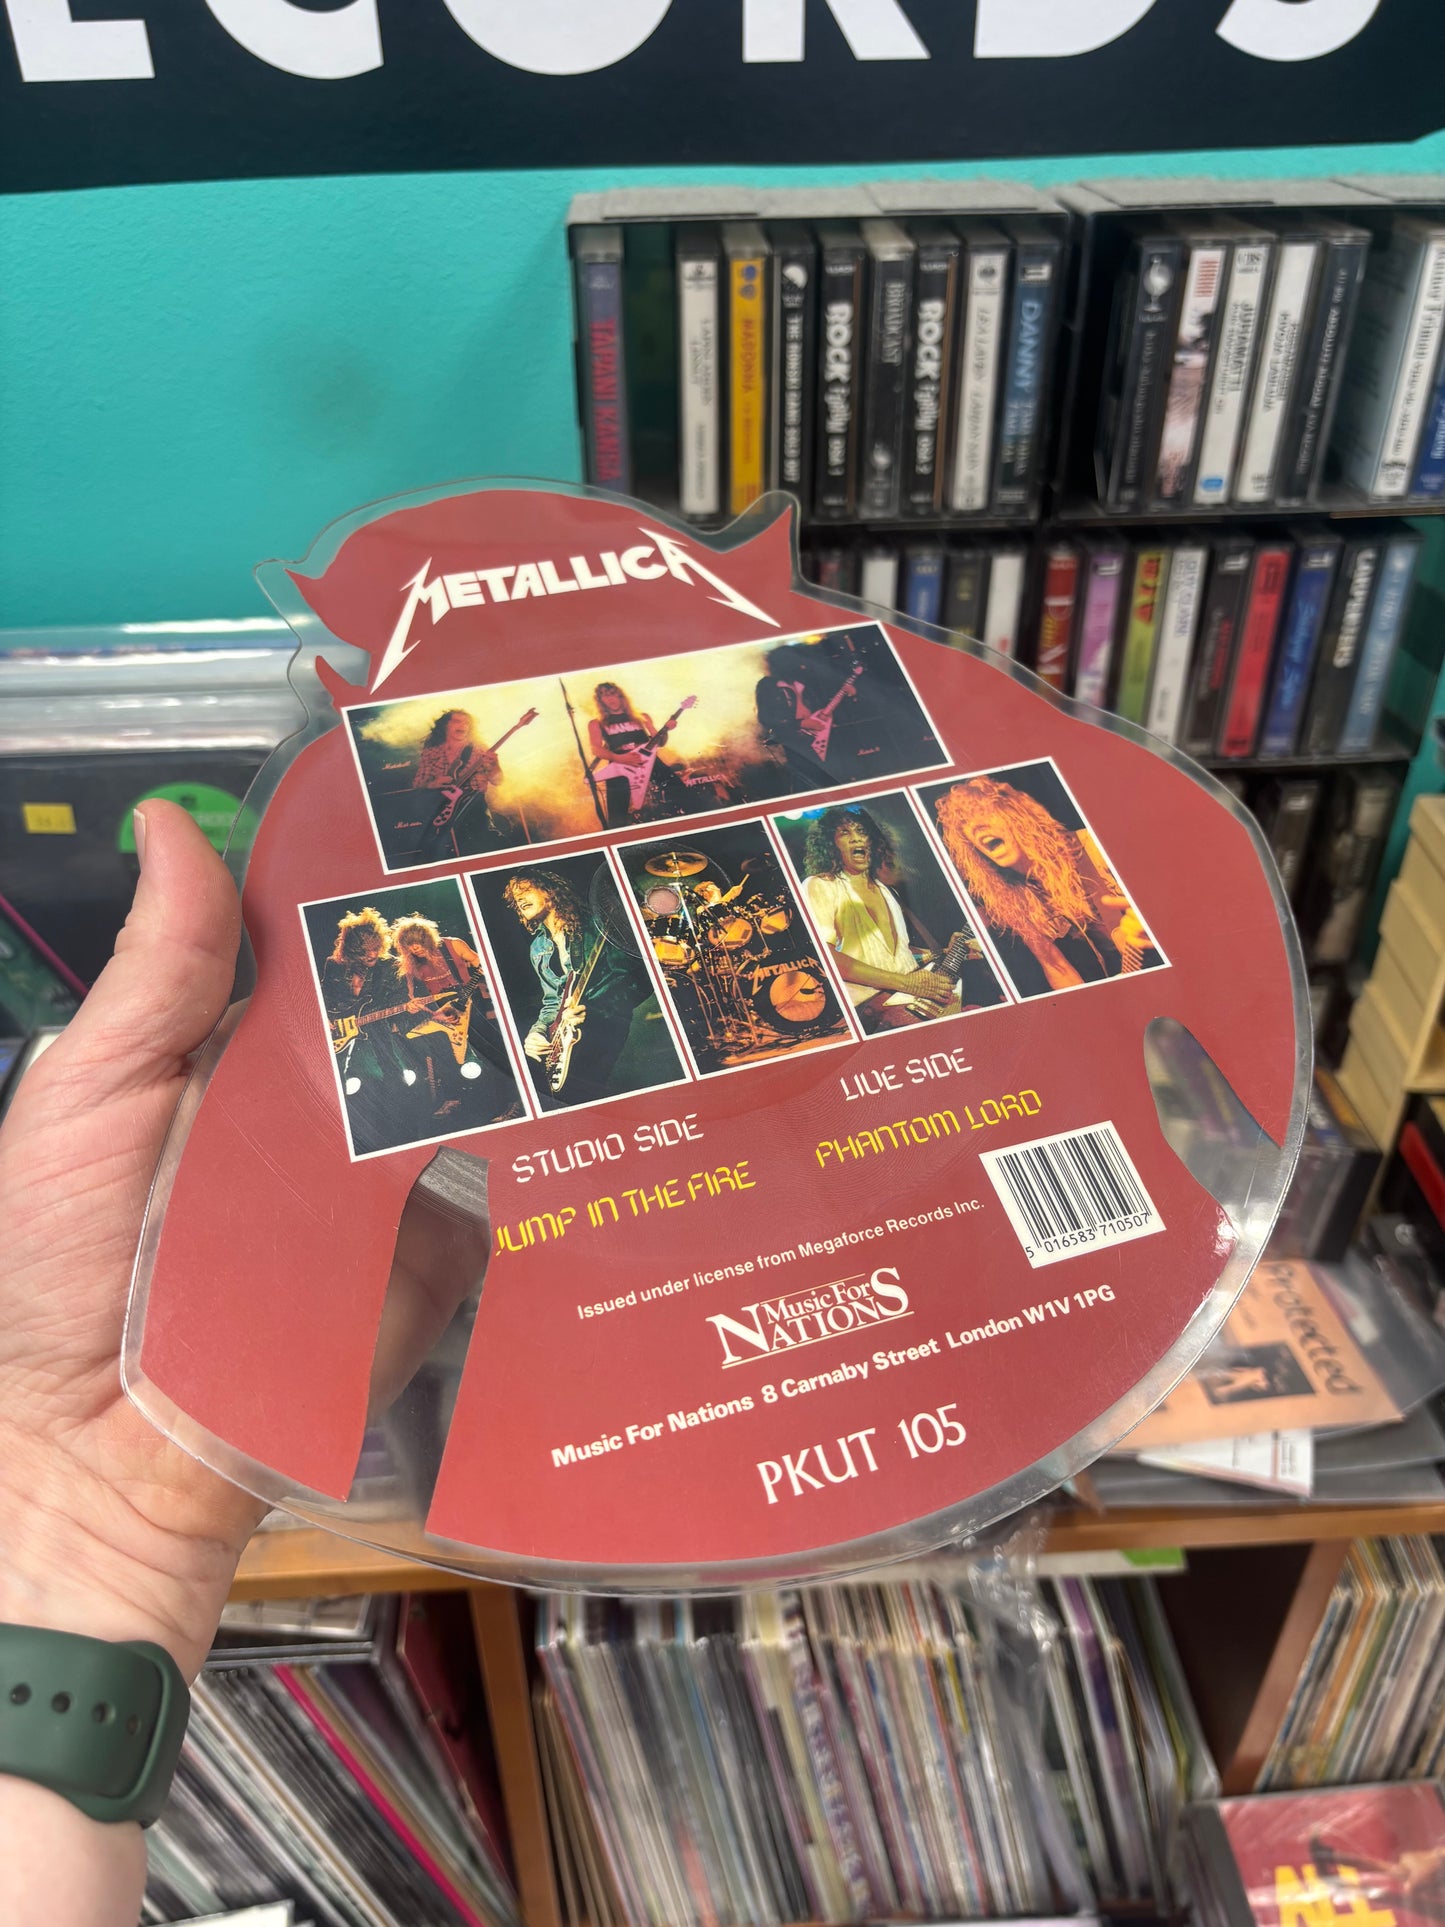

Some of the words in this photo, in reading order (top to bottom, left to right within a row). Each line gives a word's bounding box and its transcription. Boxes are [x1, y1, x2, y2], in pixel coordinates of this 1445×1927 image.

[590, 317, 618, 401] TAPANI
[742, 318, 759, 394] MADONNA
[786, 314, 803, 340] THE
[825, 301, 853, 383] ROCK
[881, 280, 906, 366] BROADCAST
[914, 300, 945, 382] ROCK
[1014, 301, 1043, 390] DANNY
[594, 406, 623, 482] KANSA
[370, 527, 781, 695] METALLICA
[1332, 548, 1377, 669] CARPENTERS
[752, 955, 827, 996] METALLICA
[839, 1064, 903, 1102] LIVE
[905, 1047, 973, 1085] SIDE
[511, 1132, 626, 1184] STUDIO
[633, 1113, 705, 1153] SIDE
[815, 1109, 961, 1169] PHANTOM
[963, 1088, 1043, 1130] LORD
[495, 1206, 577, 1257] JUMP
[586, 1196, 620, 1229] IN
[621, 1178, 686, 1217] THE
[687, 1160, 757, 1202] FIRE
[1025, 1246, 1035, 1260] 5
[1043, 1227, 1097, 1254] 016583
[1099, 1212, 1150, 1237] 710507
[577, 1290, 638, 1321] Issued
[641, 1275, 691, 1304] under
[692, 1258, 755, 1288] license
[757, 1246, 798, 1270] from
[797, 1223, 885, 1260] Megaforce
[885, 1205, 954, 1235] Records
[954, 1197, 987, 1217] Inc.
[705, 1267, 909, 1365] NATIONS
[761, 1290, 834, 1325] Music
[829, 1280, 872, 1305] For
[551, 1434, 624, 1468] Music
[625, 1421, 666, 1446] For
[667, 1395, 755, 1433] Nations
[761, 1384, 779, 1404] 8
[781, 1360, 869, 1399] Carnaby
[872, 1337, 942, 1372] Street
[945, 1315, 1024, 1349] London
[1022, 1296, 1070, 1326] W1V
[1072, 1284, 1117, 1310] 1PG
[756, 1426, 880, 1505] PKUT
[897, 1402, 968, 1460] 105
